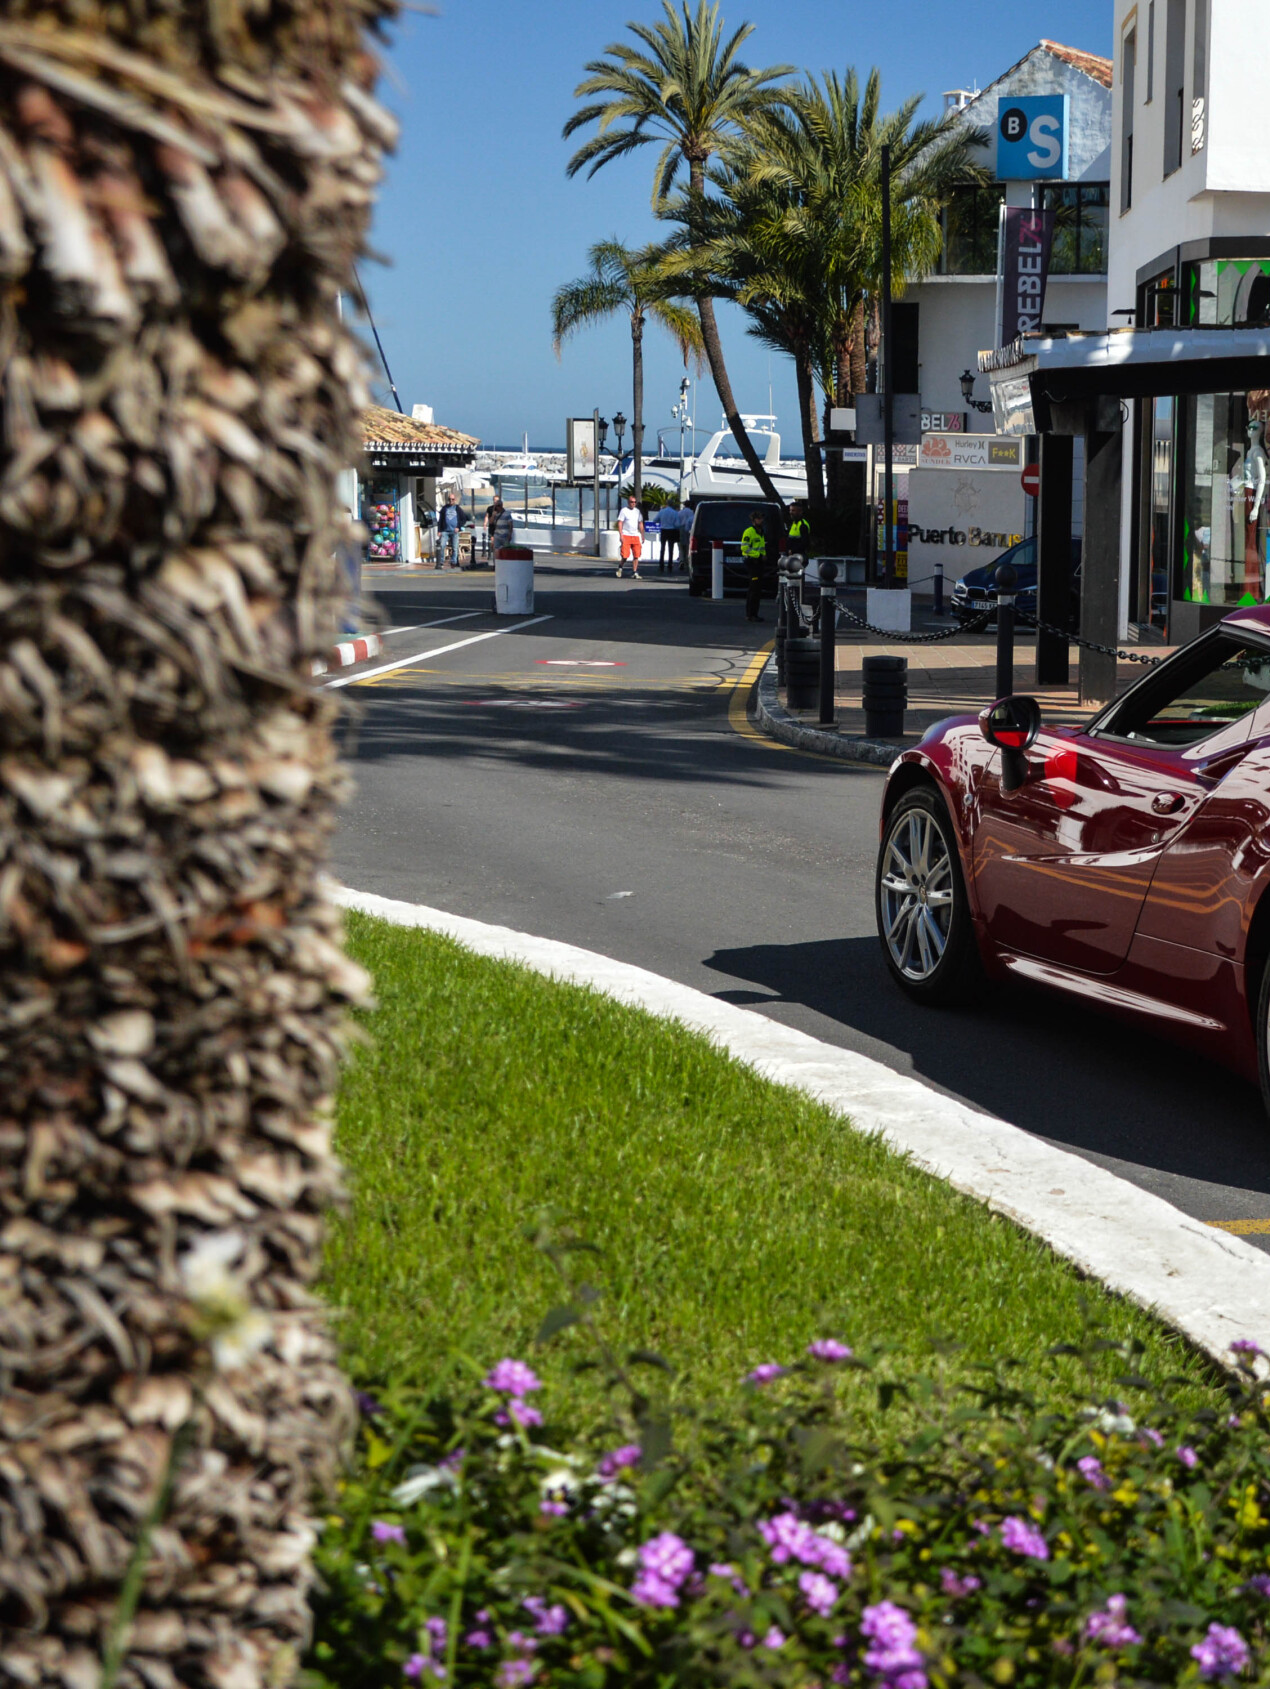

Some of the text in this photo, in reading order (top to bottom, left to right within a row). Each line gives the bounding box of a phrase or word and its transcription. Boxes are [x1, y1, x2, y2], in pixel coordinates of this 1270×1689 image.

[1017, 216, 1043, 332] REBEL76
[955, 440, 978, 450] Hurley
[954, 455, 986, 464] RVCA
[908, 523, 966, 546] Puerto
